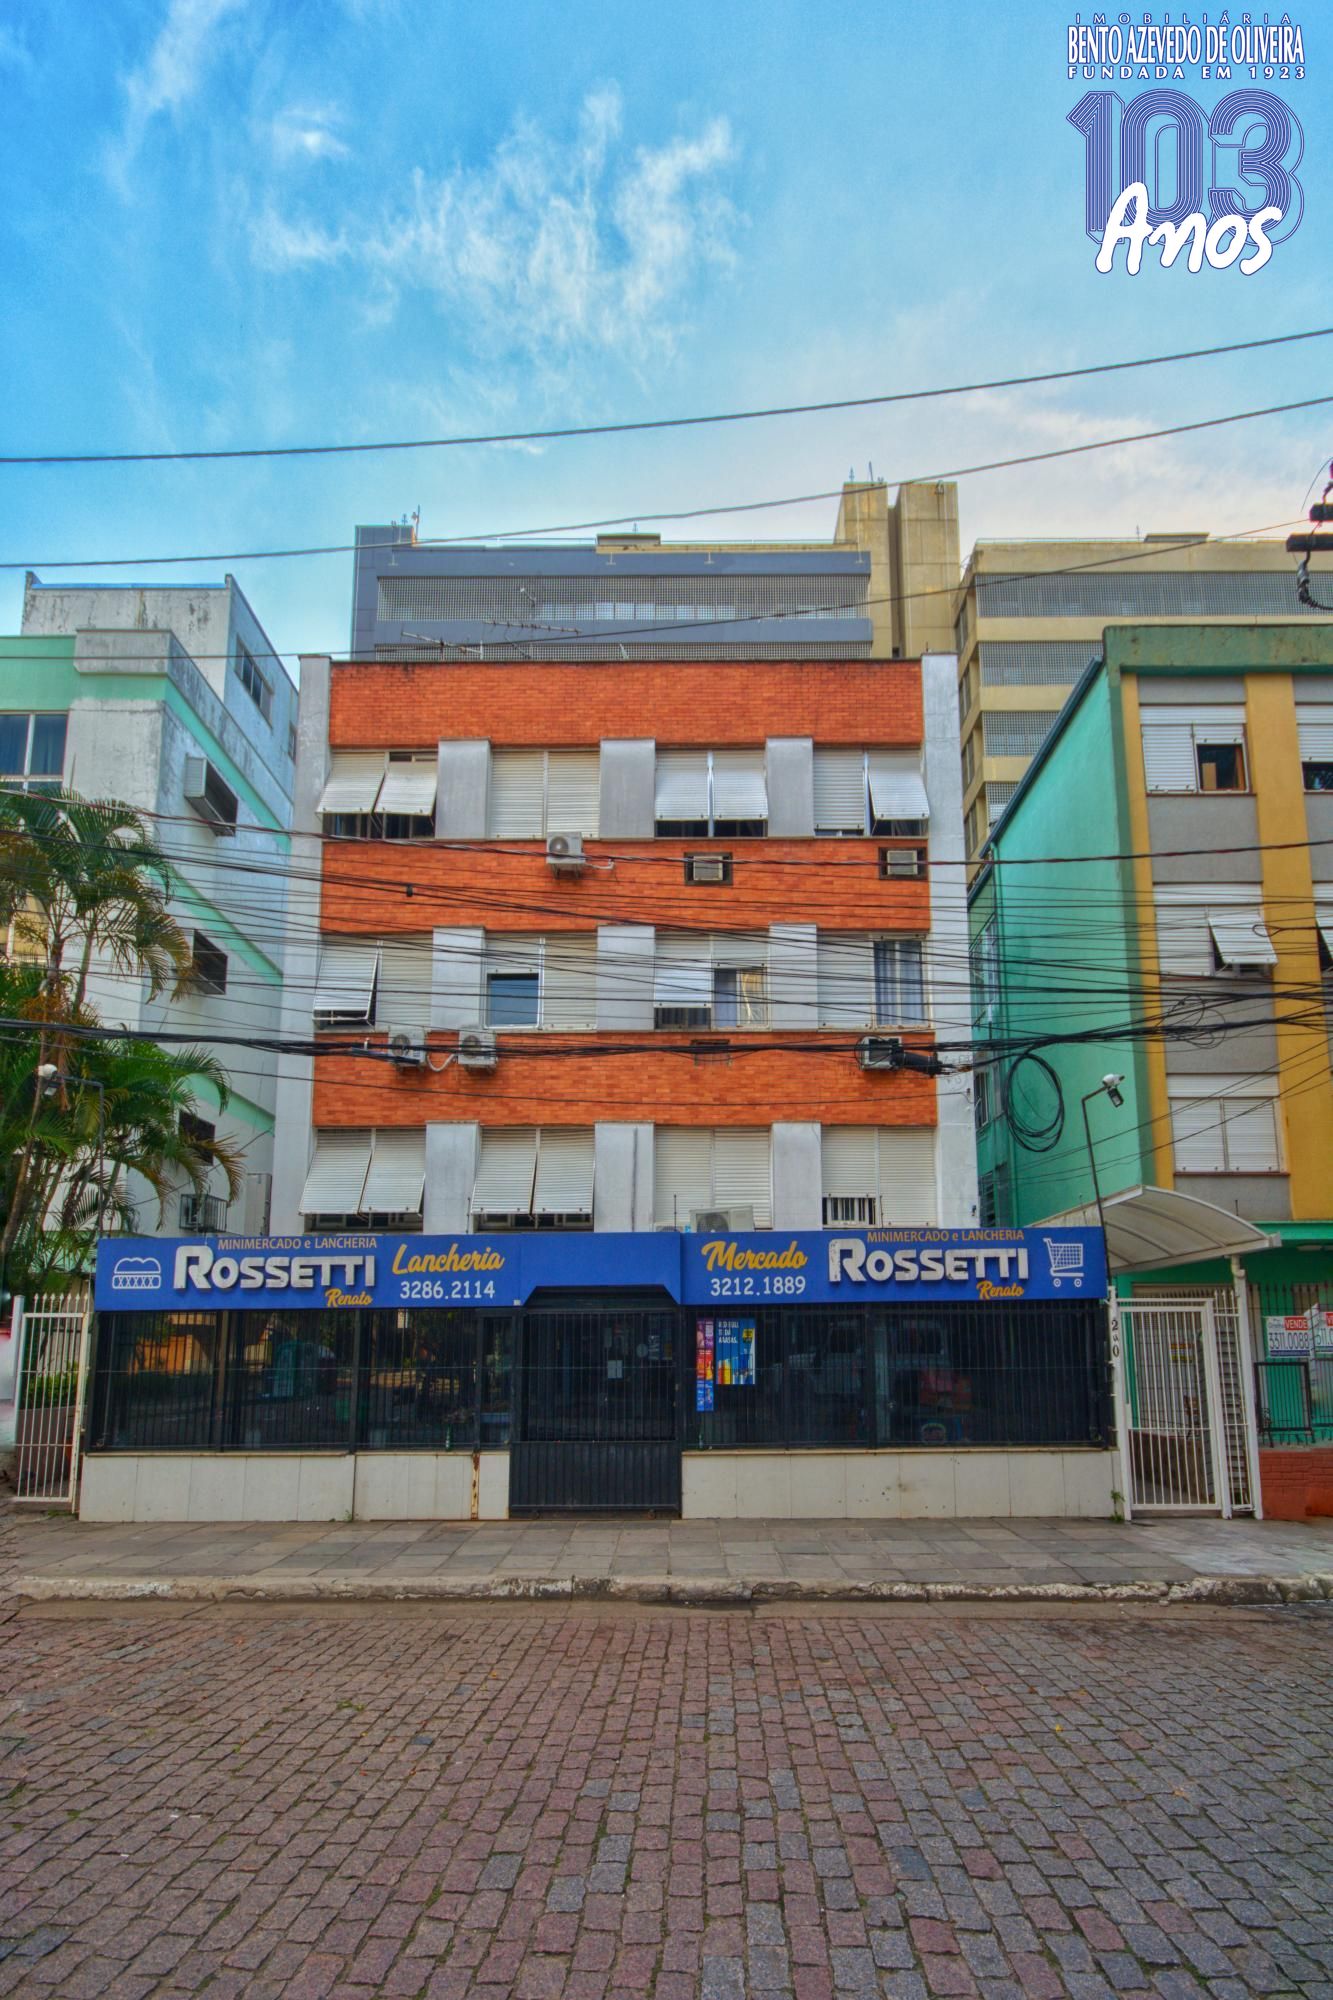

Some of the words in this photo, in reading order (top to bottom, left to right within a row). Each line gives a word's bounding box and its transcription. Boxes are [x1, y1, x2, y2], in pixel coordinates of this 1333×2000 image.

[218, 1238, 301, 1250] MINIMERCADO
[304, 1239, 311, 1249] e
[314, 1237, 377, 1249] LANCHERIA
[867, 1230, 949, 1242] MINIMERCADO
[951, 1232, 959, 1241] e
[961, 1229, 1024, 1241] LANCHERIA
[392, 1243, 505, 1275] Lancheria
[701, 1240, 808, 1271] Mercado
[829, 1238, 1028, 1281] ROSSETTI
[173, 1245, 375, 1289] ROSSETTI
[400, 1280, 496, 1299] 3286.2114
[710, 1276, 806, 1296] 3212.1889
[976, 1280, 1024, 1300] Renato
[325, 1287, 373, 1308] Renato
[1285, 1319, 1308, 1329] VENDE
